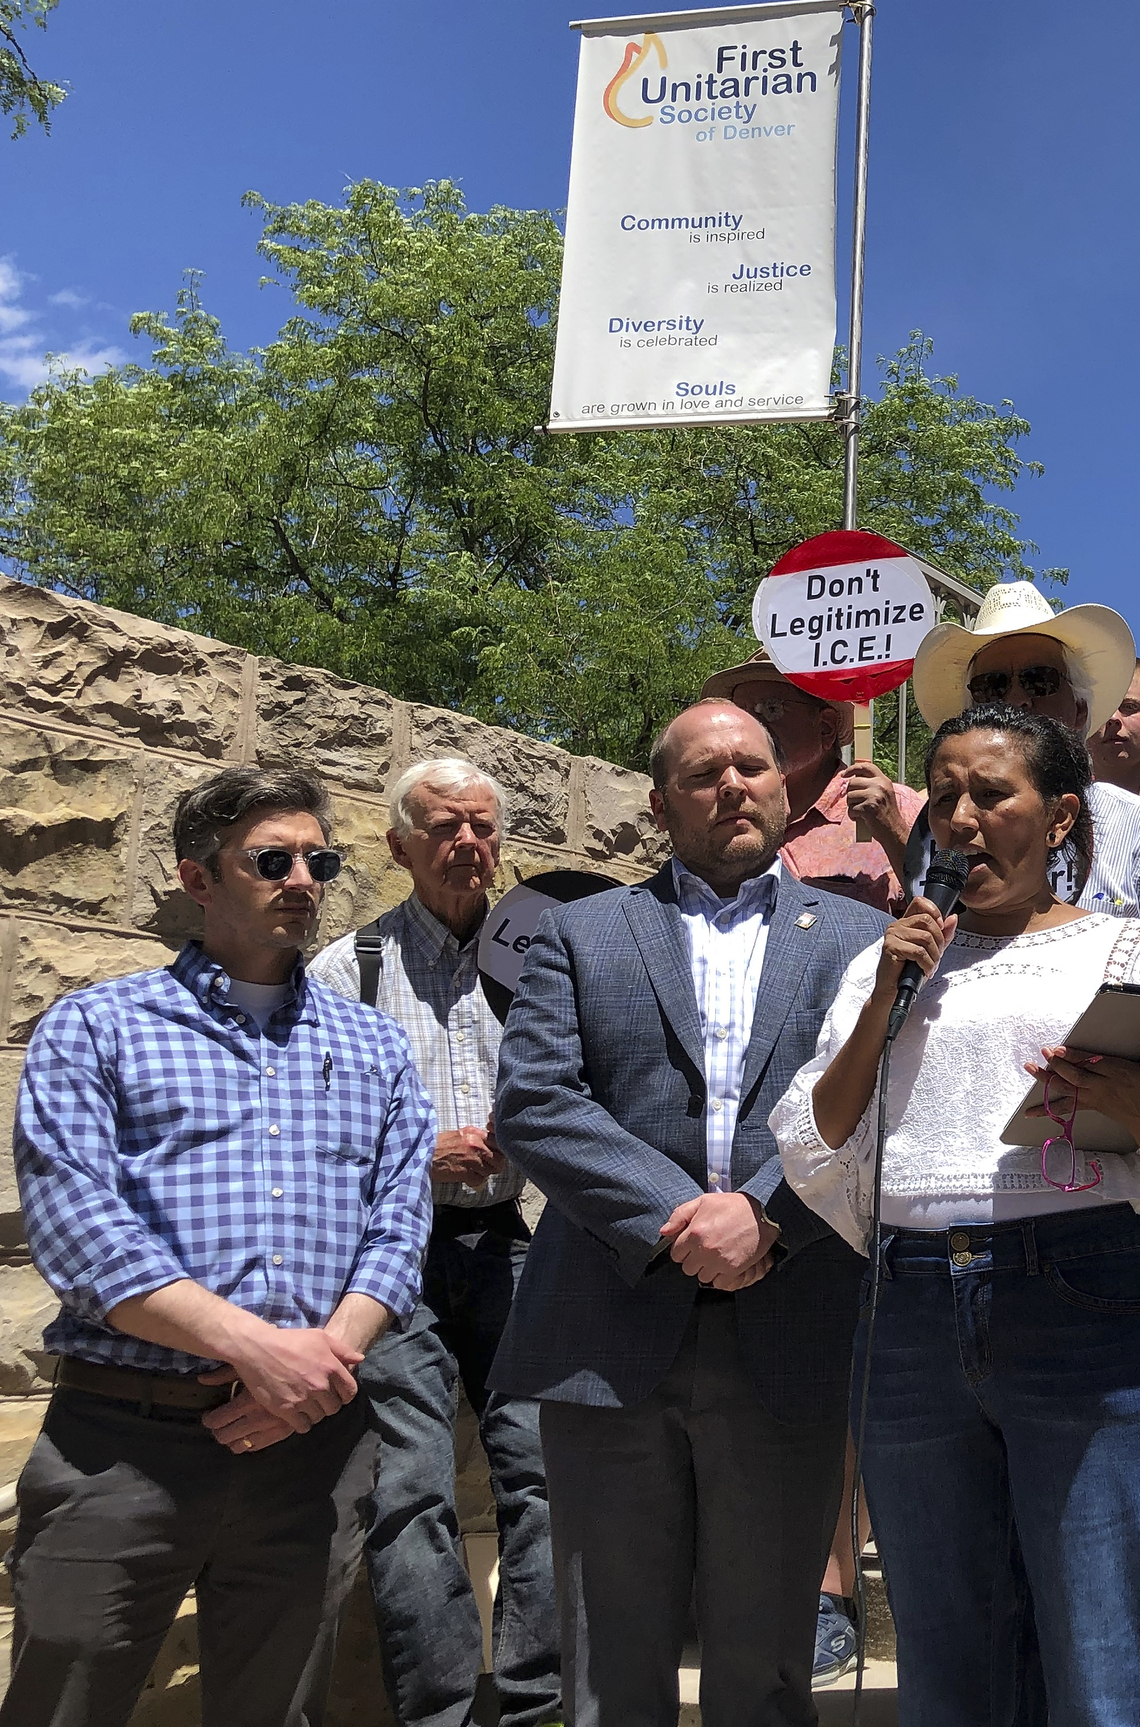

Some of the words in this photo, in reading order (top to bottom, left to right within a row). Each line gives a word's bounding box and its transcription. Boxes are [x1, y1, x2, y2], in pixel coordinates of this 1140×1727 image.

[716, 39, 804, 74] First
[641, 68, 817, 104] Unitarian
[659, 100, 757, 125] Society
[695, 126, 716, 142] of
[723, 123, 796, 140] Denver
[620, 211, 743, 231] Community
[689, 231, 701, 243] is
[705, 228, 766, 244] inspired
[732, 262, 812, 280] Justice
[707, 282, 719, 294] is
[724, 280, 783, 293] realized
[608, 315, 705, 335] Diversity
[619, 337, 631, 349] is
[636, 334, 718, 348] celebrated
[675, 381, 737, 397] Souls
[581, 402, 606, 415] are
[610, 401, 657, 416] grown
[662, 399, 675, 411] in
[680, 397, 710, 410] love
[714, 396, 743, 409] and
[748, 394, 804, 407] service
[806, 568, 880, 600] Don't
[770, 600, 925, 640] Legitimize
[813, 634, 892, 667] I.C.E.!
